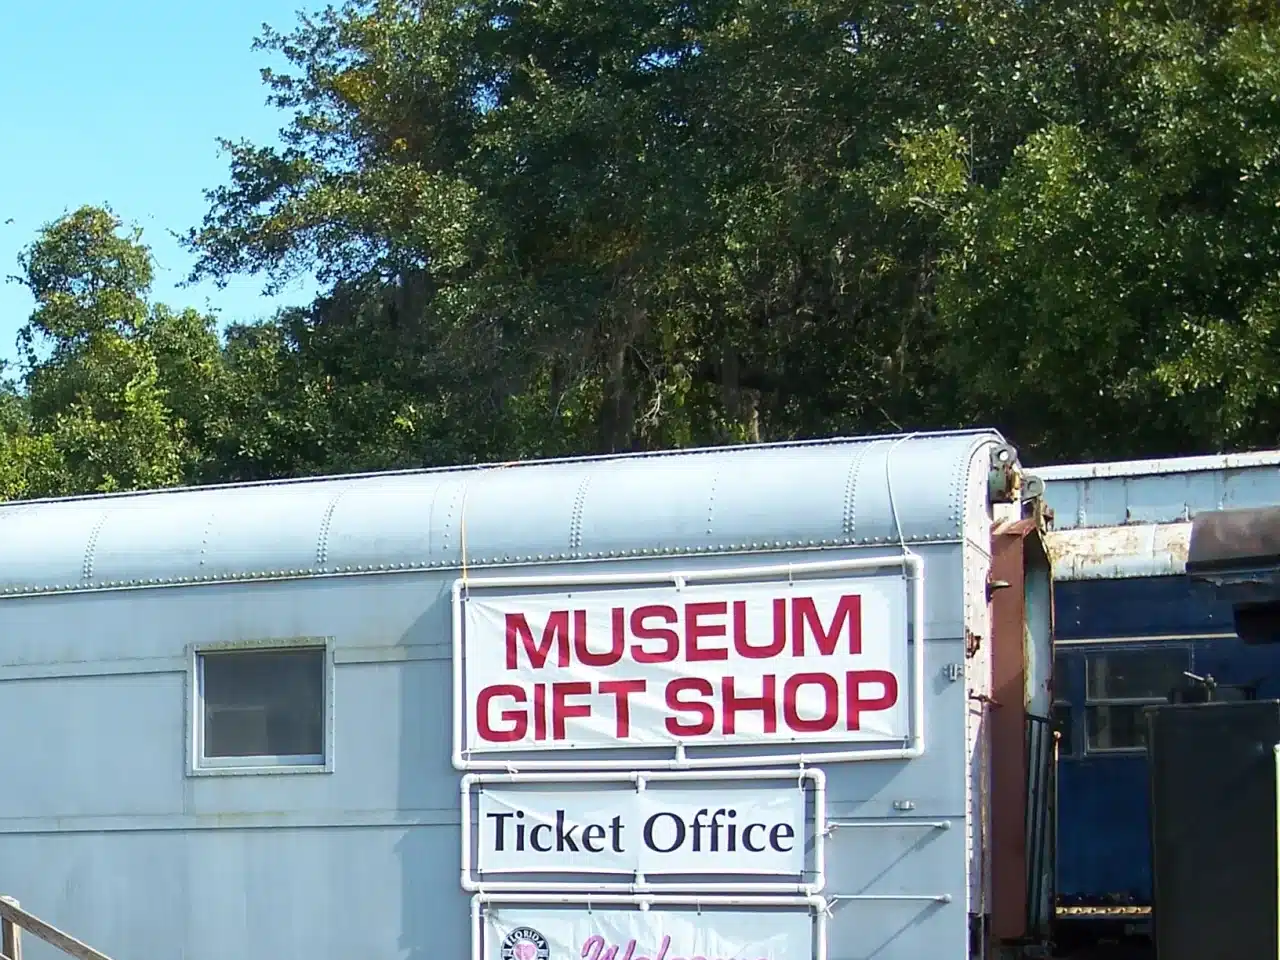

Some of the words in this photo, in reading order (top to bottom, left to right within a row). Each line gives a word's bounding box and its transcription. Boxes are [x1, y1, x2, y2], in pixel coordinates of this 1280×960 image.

[505, 594, 861, 669] MUSEUM
[476, 679, 647, 742] GIFT
[664, 669, 900, 737] SHOP
[486, 810, 625, 852] Ticket
[642, 808, 796, 853] Office
[506, 930, 544, 947] FLORIDA
